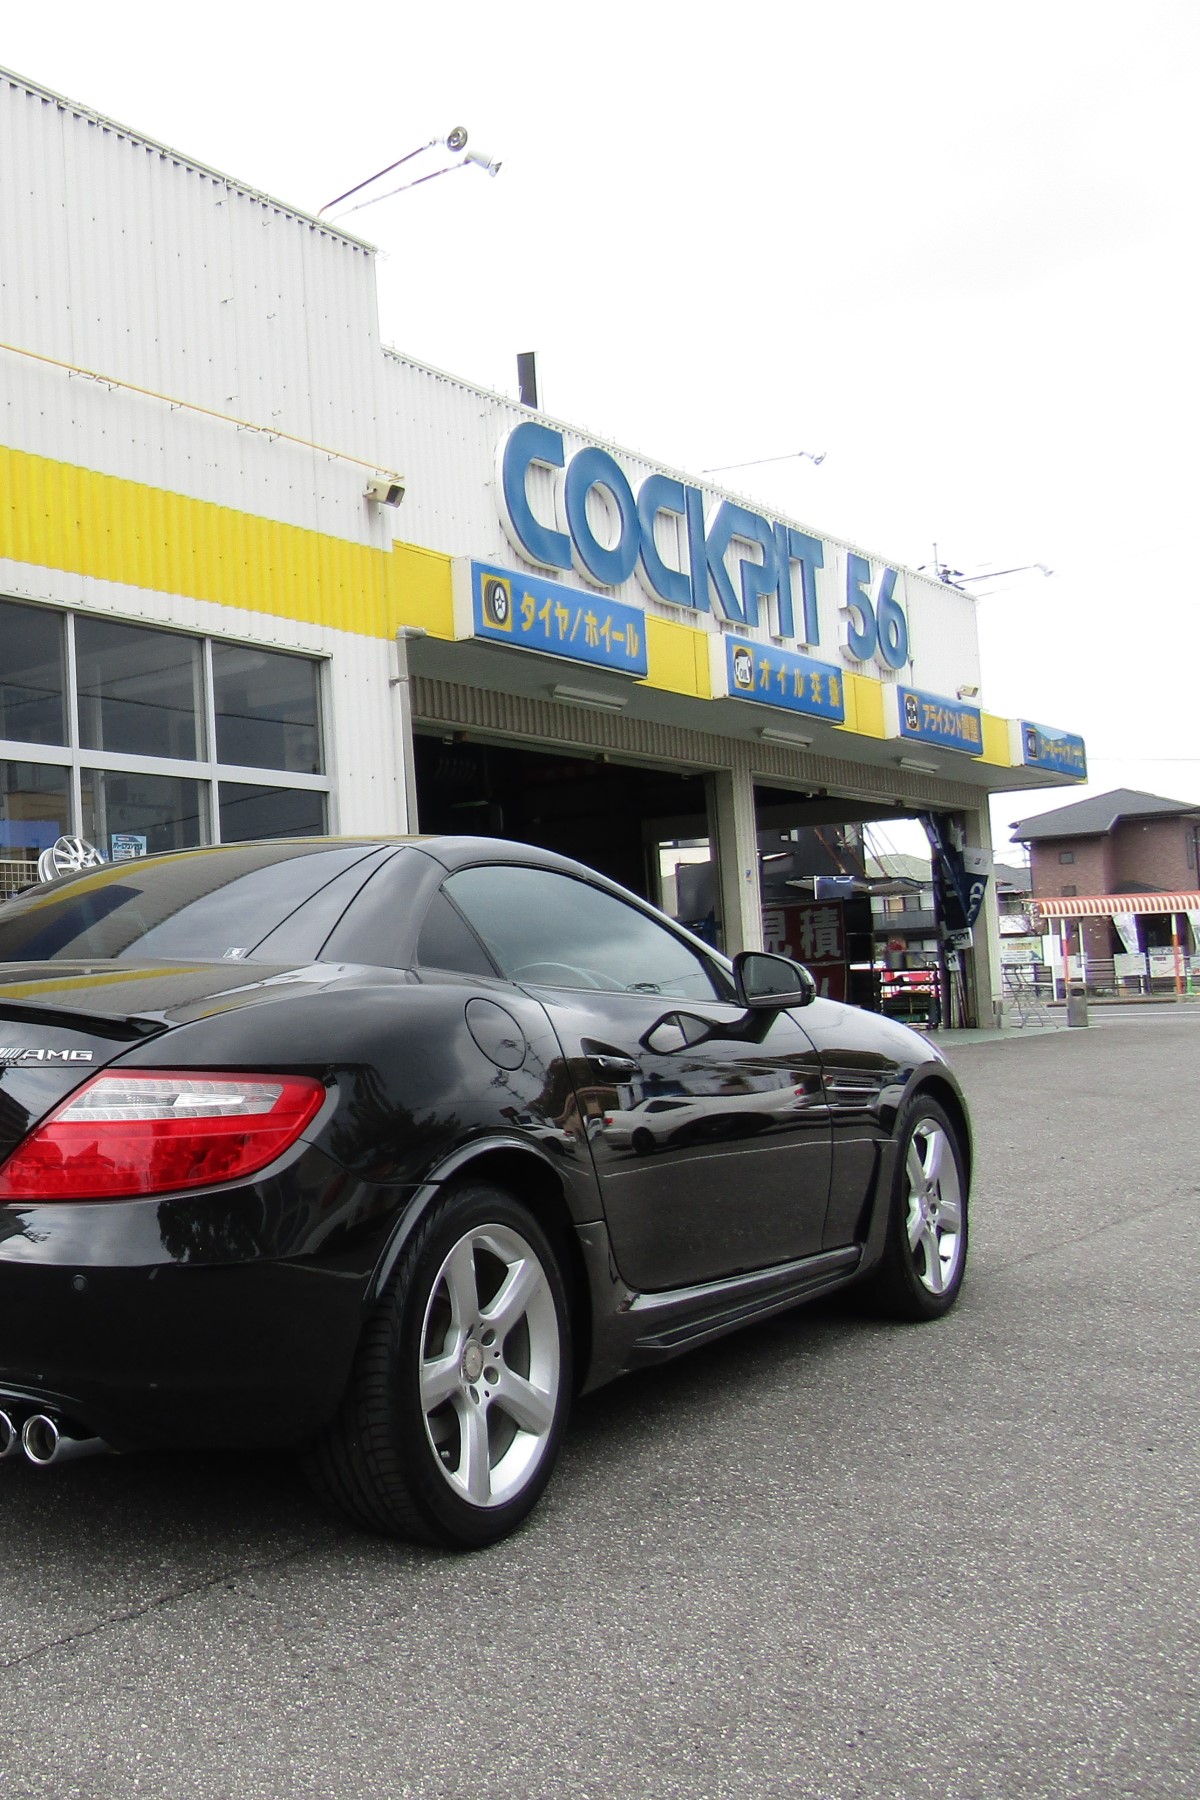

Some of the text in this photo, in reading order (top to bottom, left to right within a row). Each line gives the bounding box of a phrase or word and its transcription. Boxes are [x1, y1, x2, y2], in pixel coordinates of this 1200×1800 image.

[498, 421, 908, 670] COCKPIT 56
[21, 1049, 93, 1061] AMG
